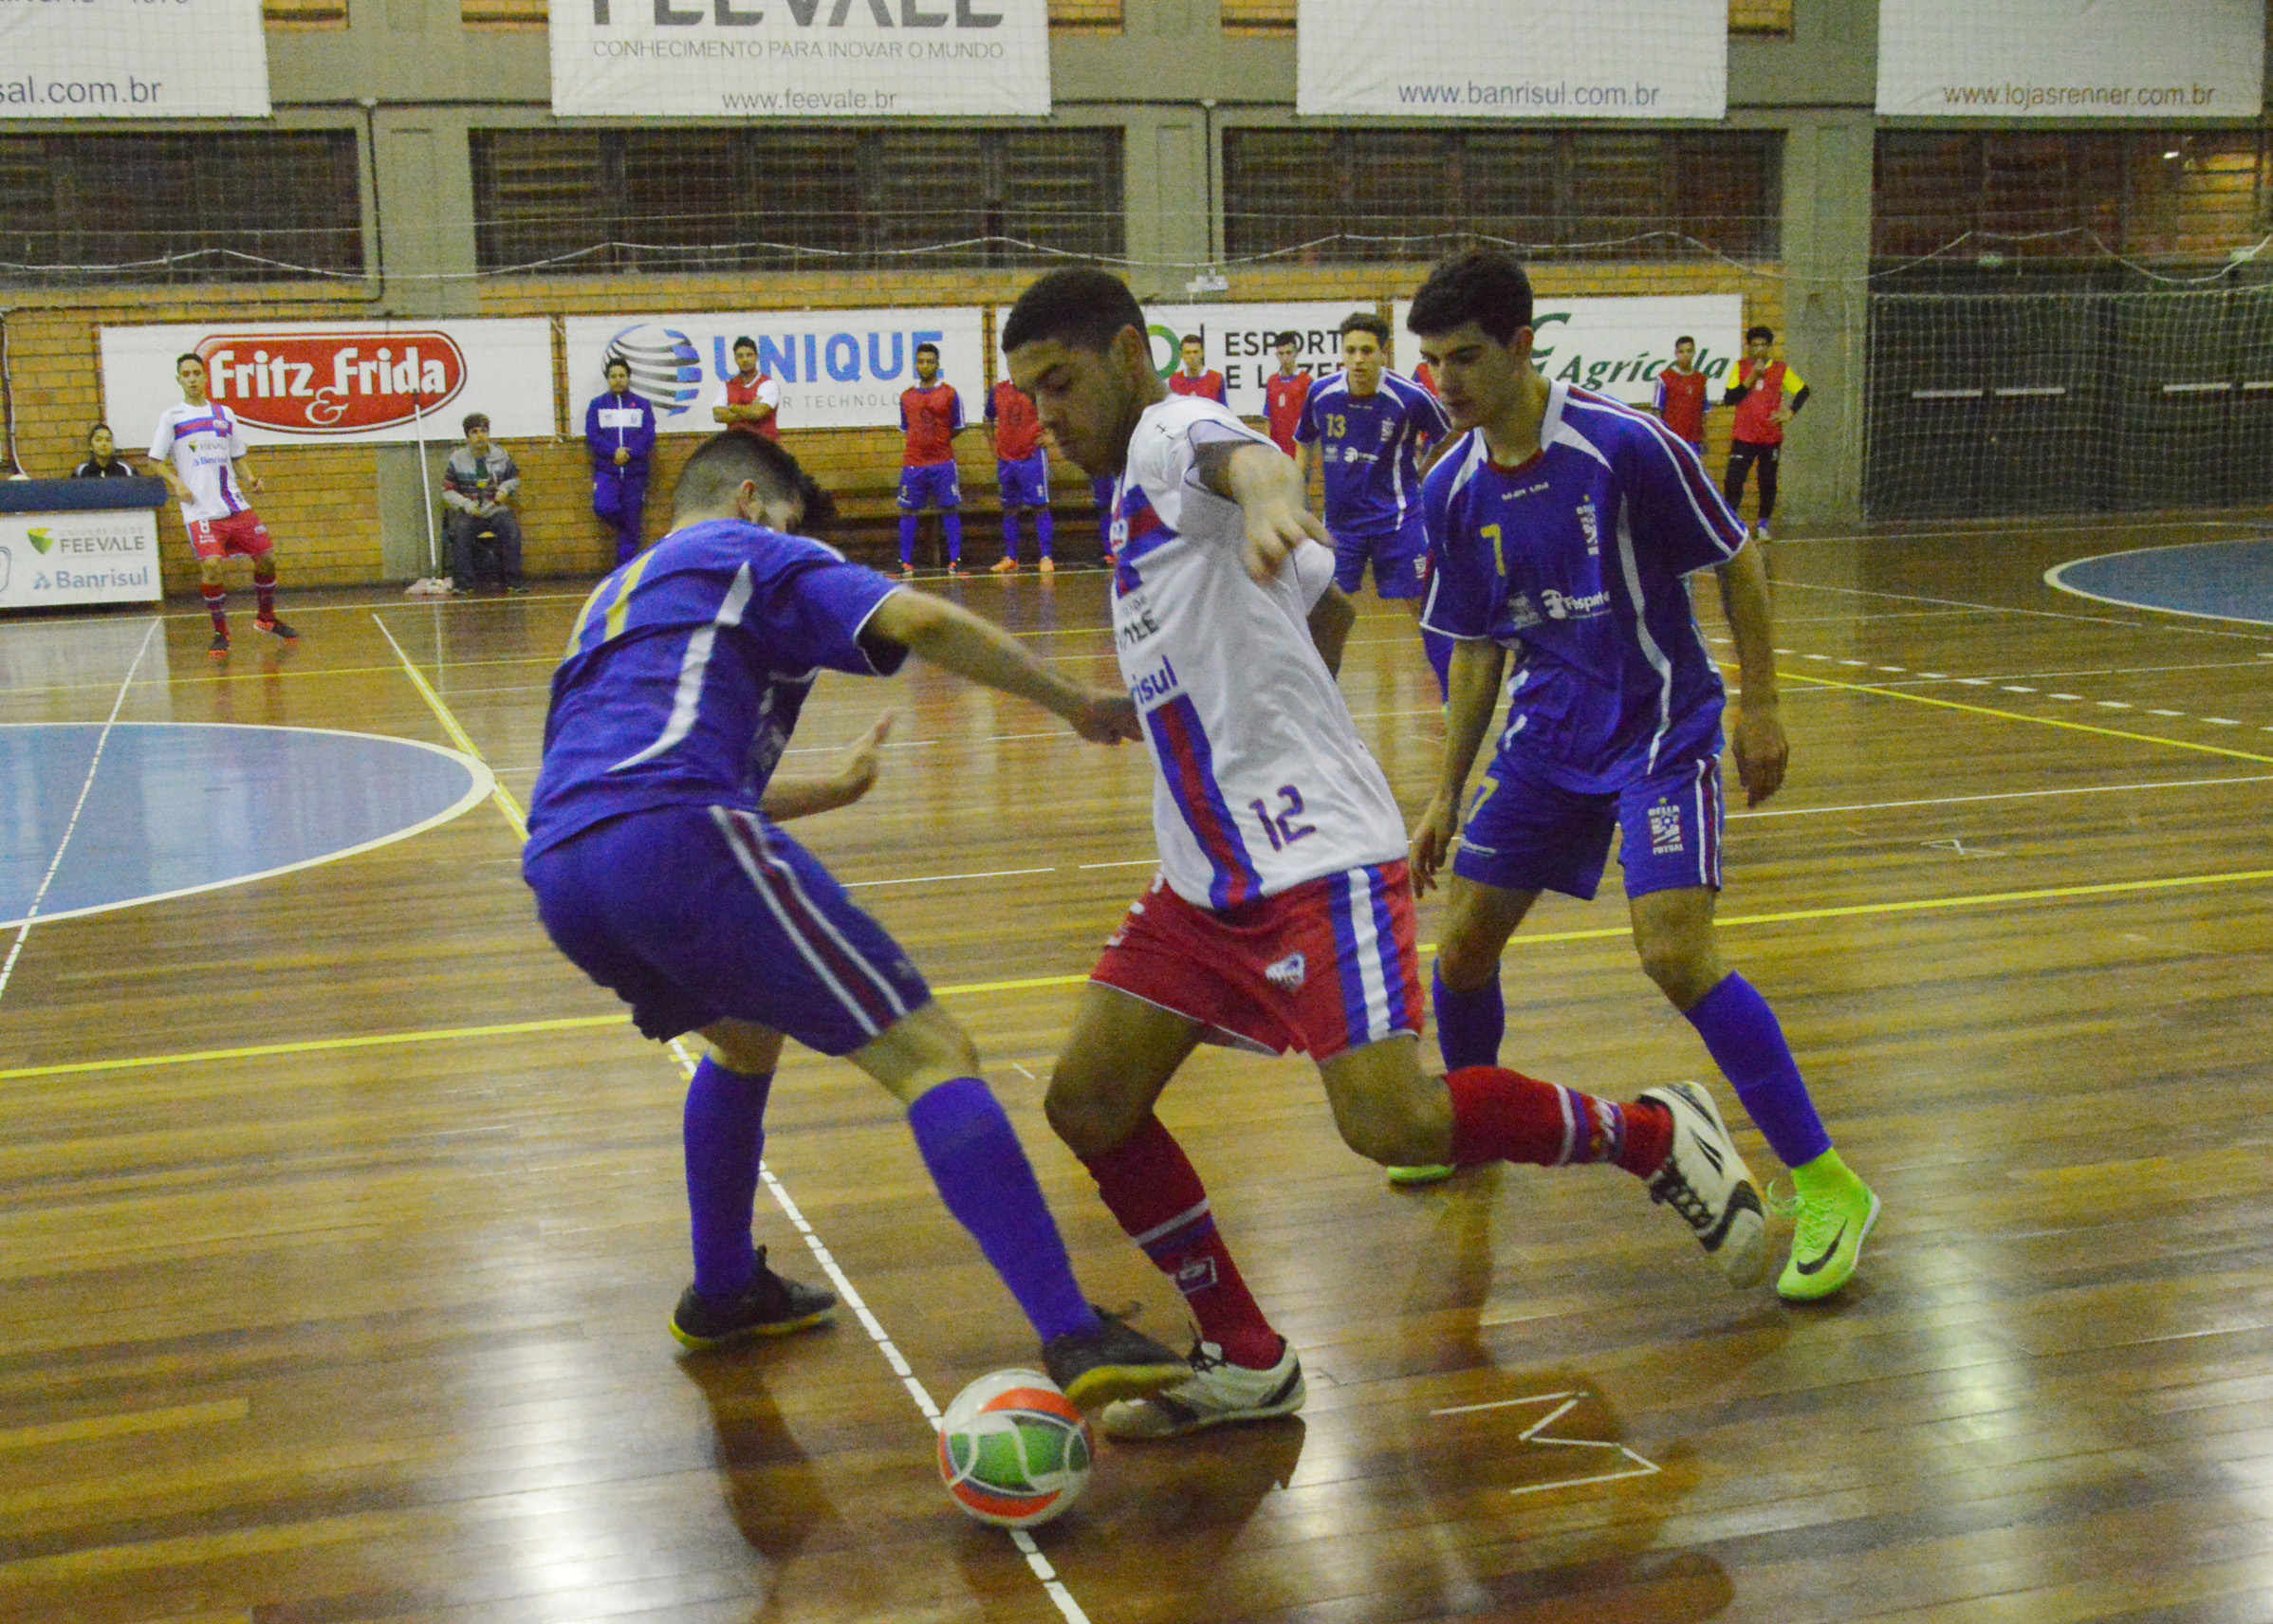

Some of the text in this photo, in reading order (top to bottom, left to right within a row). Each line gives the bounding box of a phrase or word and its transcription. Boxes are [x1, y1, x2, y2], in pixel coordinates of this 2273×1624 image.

[593, 40, 1005, 59] CONHECIMENTO PARA INOVAR O MUNDO
[722, 88, 896, 110] www.feevale.br
[1397, 81, 1659, 105] www.banrisul.com.br
[1943, 82, 2216, 111] www.lojasrenner.com.br
[209, 346, 447, 399] Fritz Frida
[1226, 364, 1242, 390] E
[1556, 348, 1731, 392] Agrícla
[1326, 413, 1346, 438] 13
[60, 536, 145, 554] FEEVALE
[1480, 523, 1506, 577] 7
[56, 566, 149, 589] Banrisul
[1248, 784, 1317, 852] 12
